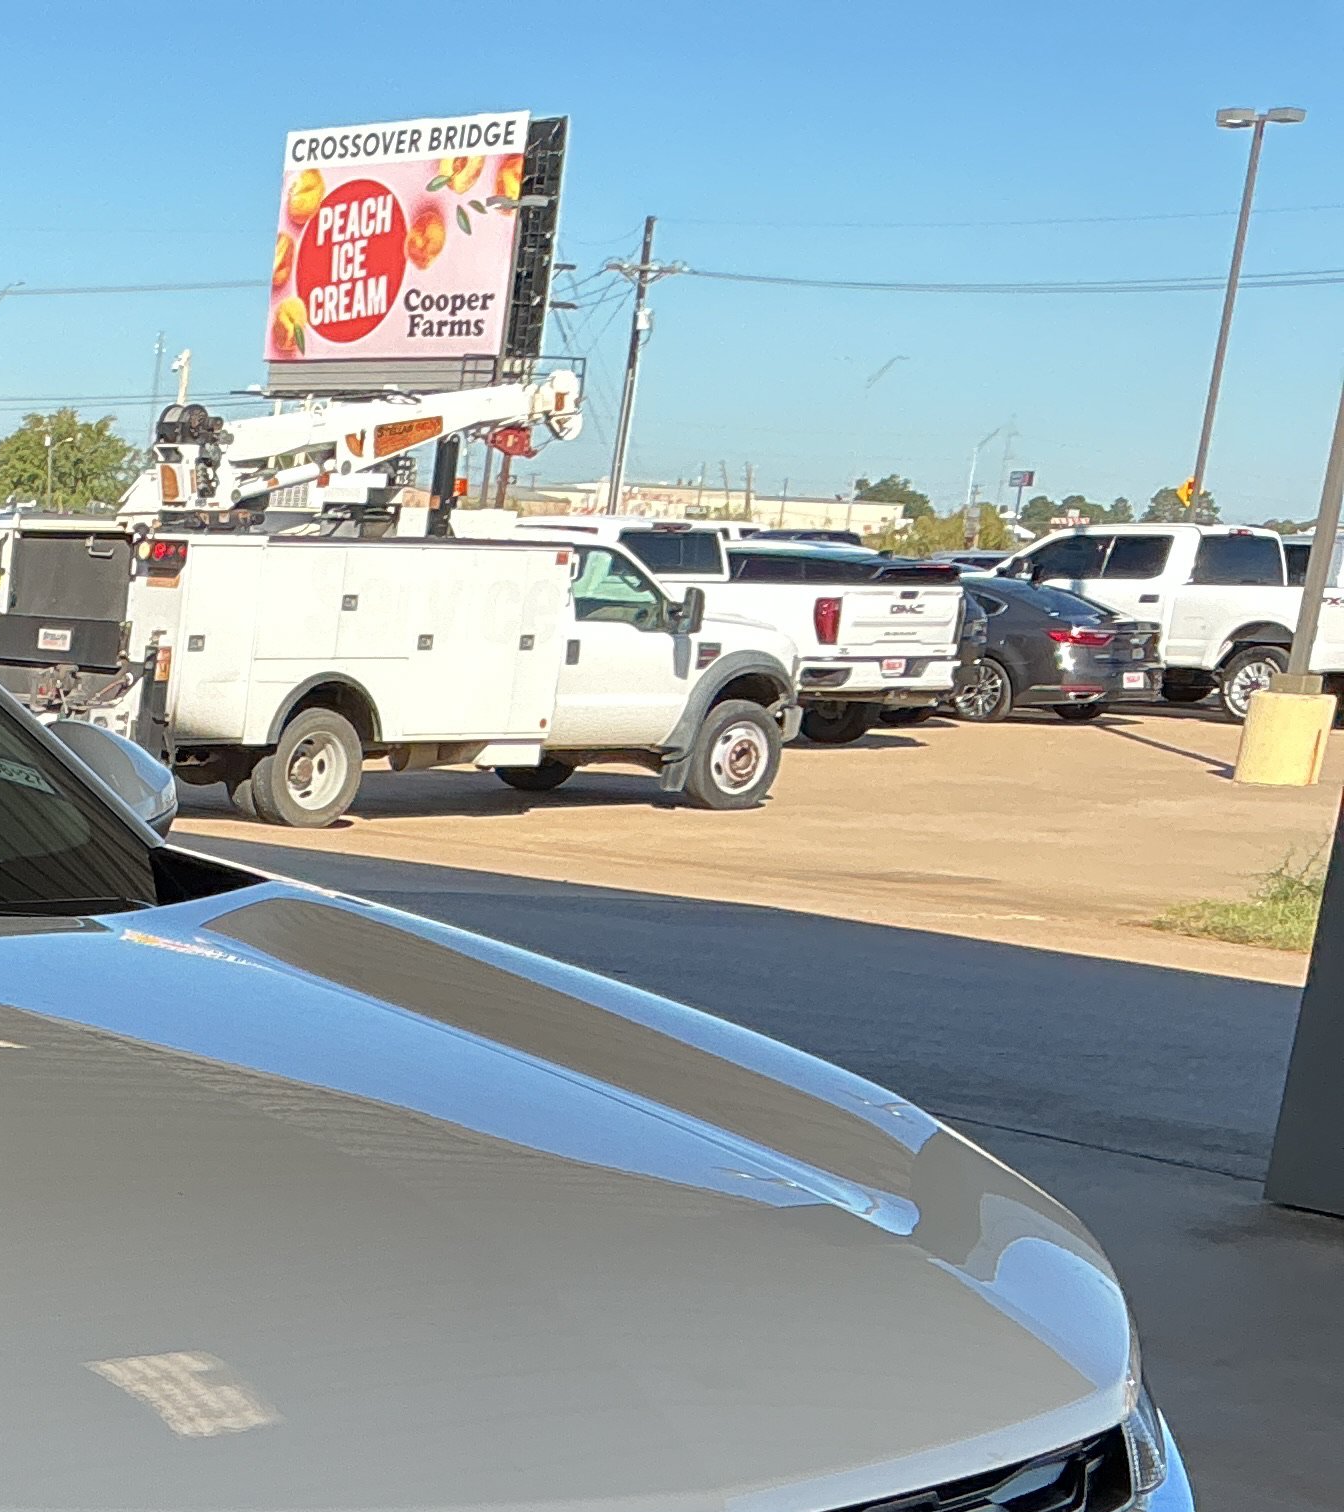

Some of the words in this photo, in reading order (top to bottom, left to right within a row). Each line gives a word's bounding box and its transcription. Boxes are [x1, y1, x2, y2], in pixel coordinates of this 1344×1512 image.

[291, 128, 422, 163] CROSSOVER
[428, 120, 517, 152] BRIDGE
[316, 193, 394, 247] PEACH
[331, 239, 368, 283] ICE
[308, 274, 388, 327] CREAM
[403, 288, 495, 317] Cooper
[407, 313, 486, 338] Farms
